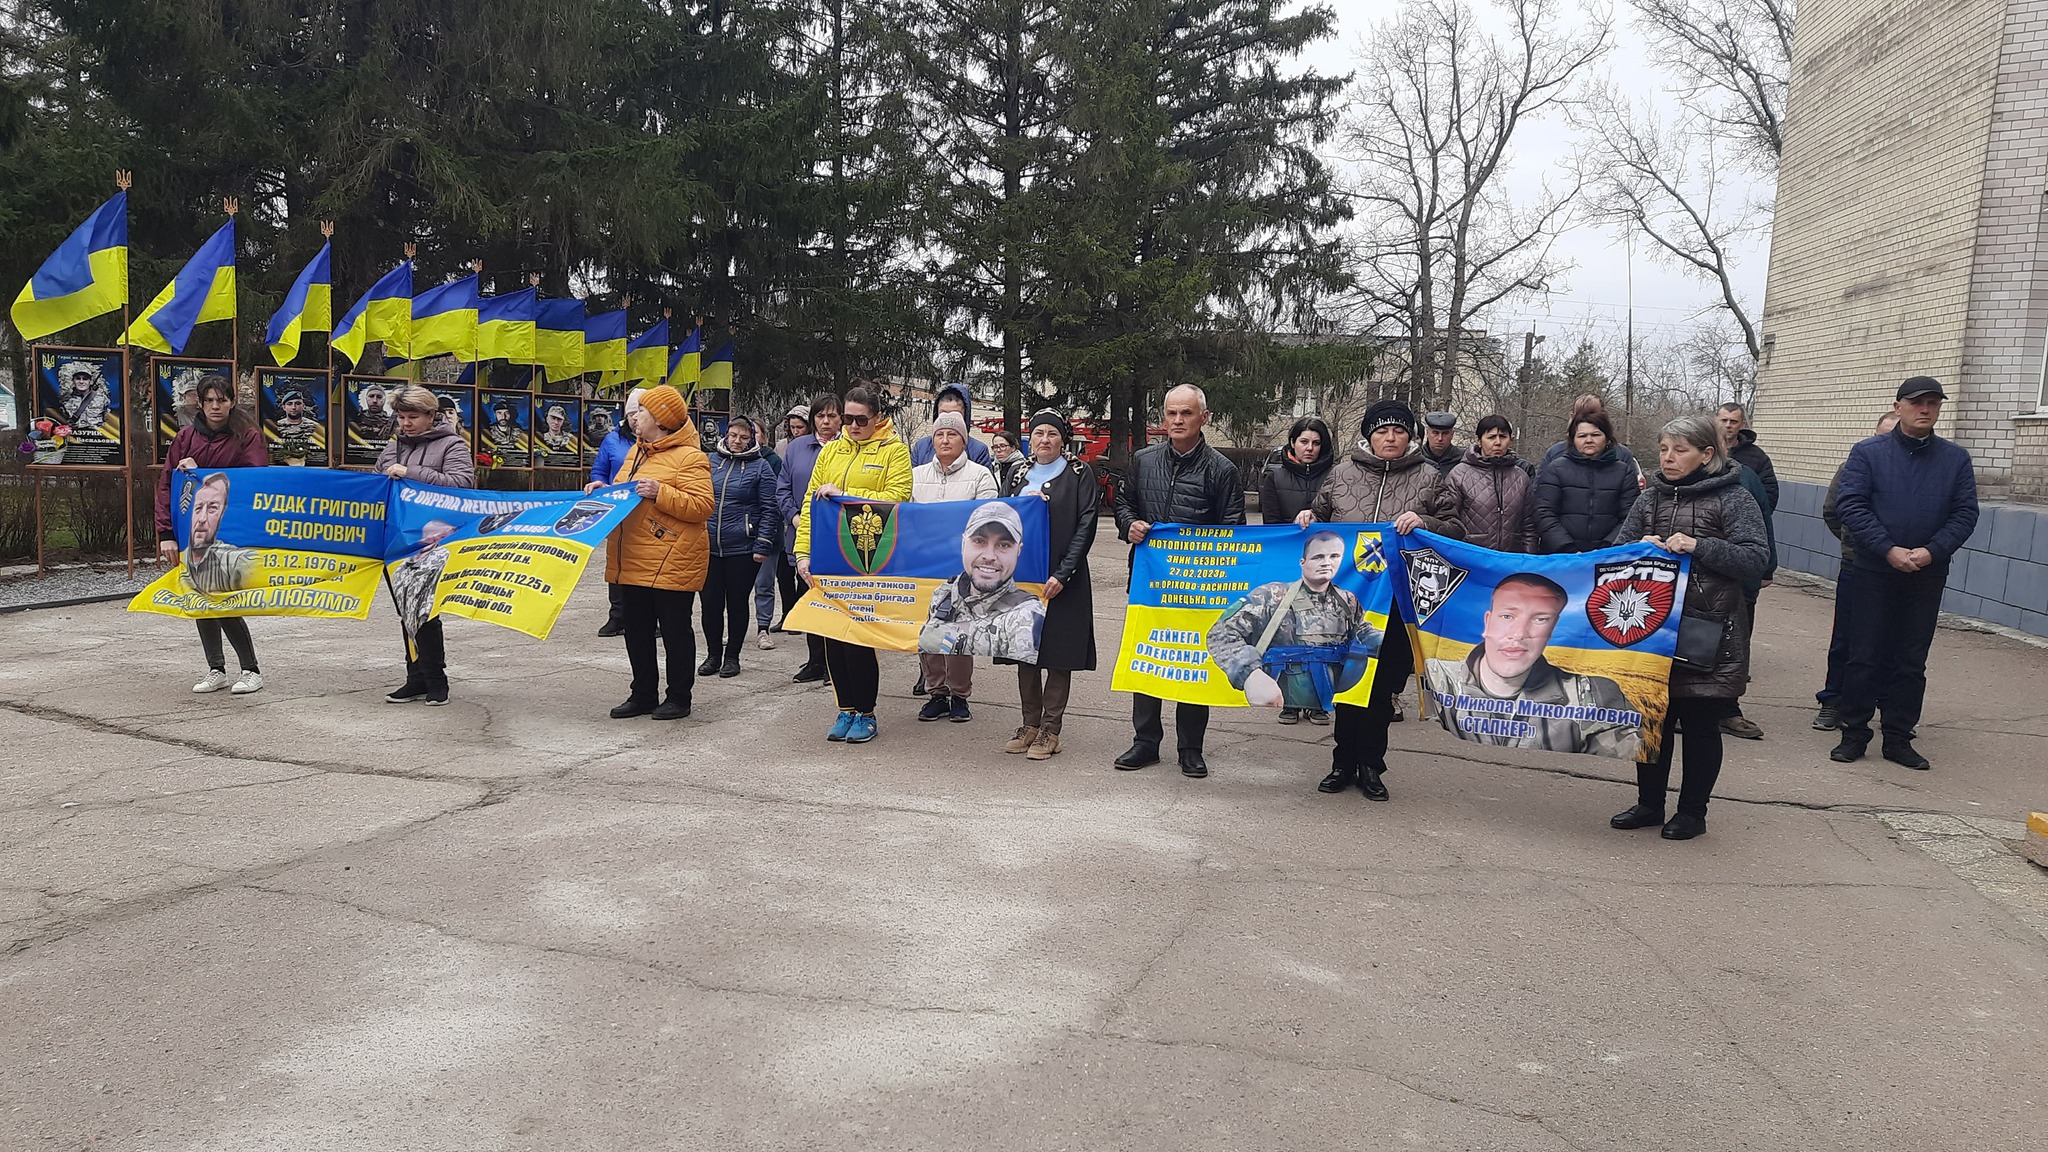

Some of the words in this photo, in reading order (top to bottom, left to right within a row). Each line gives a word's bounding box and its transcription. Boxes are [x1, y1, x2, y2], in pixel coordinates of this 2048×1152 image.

[252, 493, 308, 514] БУДАК
[309, 497, 386, 521] ГРИГОРІЙ
[400, 487, 417, 502] 42
[414, 490, 461, 511] ОКРЕМА
[460, 498, 571, 515] МЕХАНІЗО
[265, 519, 367, 543] ФЕДОРОВИЧ
[1179, 528, 1191, 537] 56
[1195, 528, 1234, 538] ОКРЕМА
[518, 542, 579, 564] Вікторович
[1148, 539, 1214, 552] МОТОПІХОТНА
[1216, 542, 1262, 553] БРИГАДА
[1166, 554, 1191, 565] ЗНИК
[1193, 555, 1237, 566] БЕЗВІСТИ
[268, 575, 285, 587] 59
[460, 568, 503, 580] безвісти
[502, 571, 544, 590] 17.12.25
[1169, 567, 1228, 578] 27.02.2023р.
[470, 580, 516, 599] Торецьк
[819, 578, 840, 588] 17-та
[840, 580, 875, 590] окрема
[876, 581, 916, 590] танкова
[269, 588, 361, 613] ЛЮБИМО!
[874, 592, 916, 604] бригада
[1161, 593, 1207, 605] ДОНЕЦЬКА
[1209, 597, 1230, 605] обл.
[490, 601, 514, 615] обл.
[848, 603, 875, 613] імені
[1149, 628, 1201, 645] ДЕЙНЕГА
[1136, 642, 1209, 666] ОЛЕКСАНДР
[1130, 659, 1208, 683] СЕРГІЙОВИЧ
[1455, 694, 1514, 714] Микола
[1517, 698, 1642, 728] Миколайович
[1458, 716, 1537, 738] «СТАЛКЕР»
